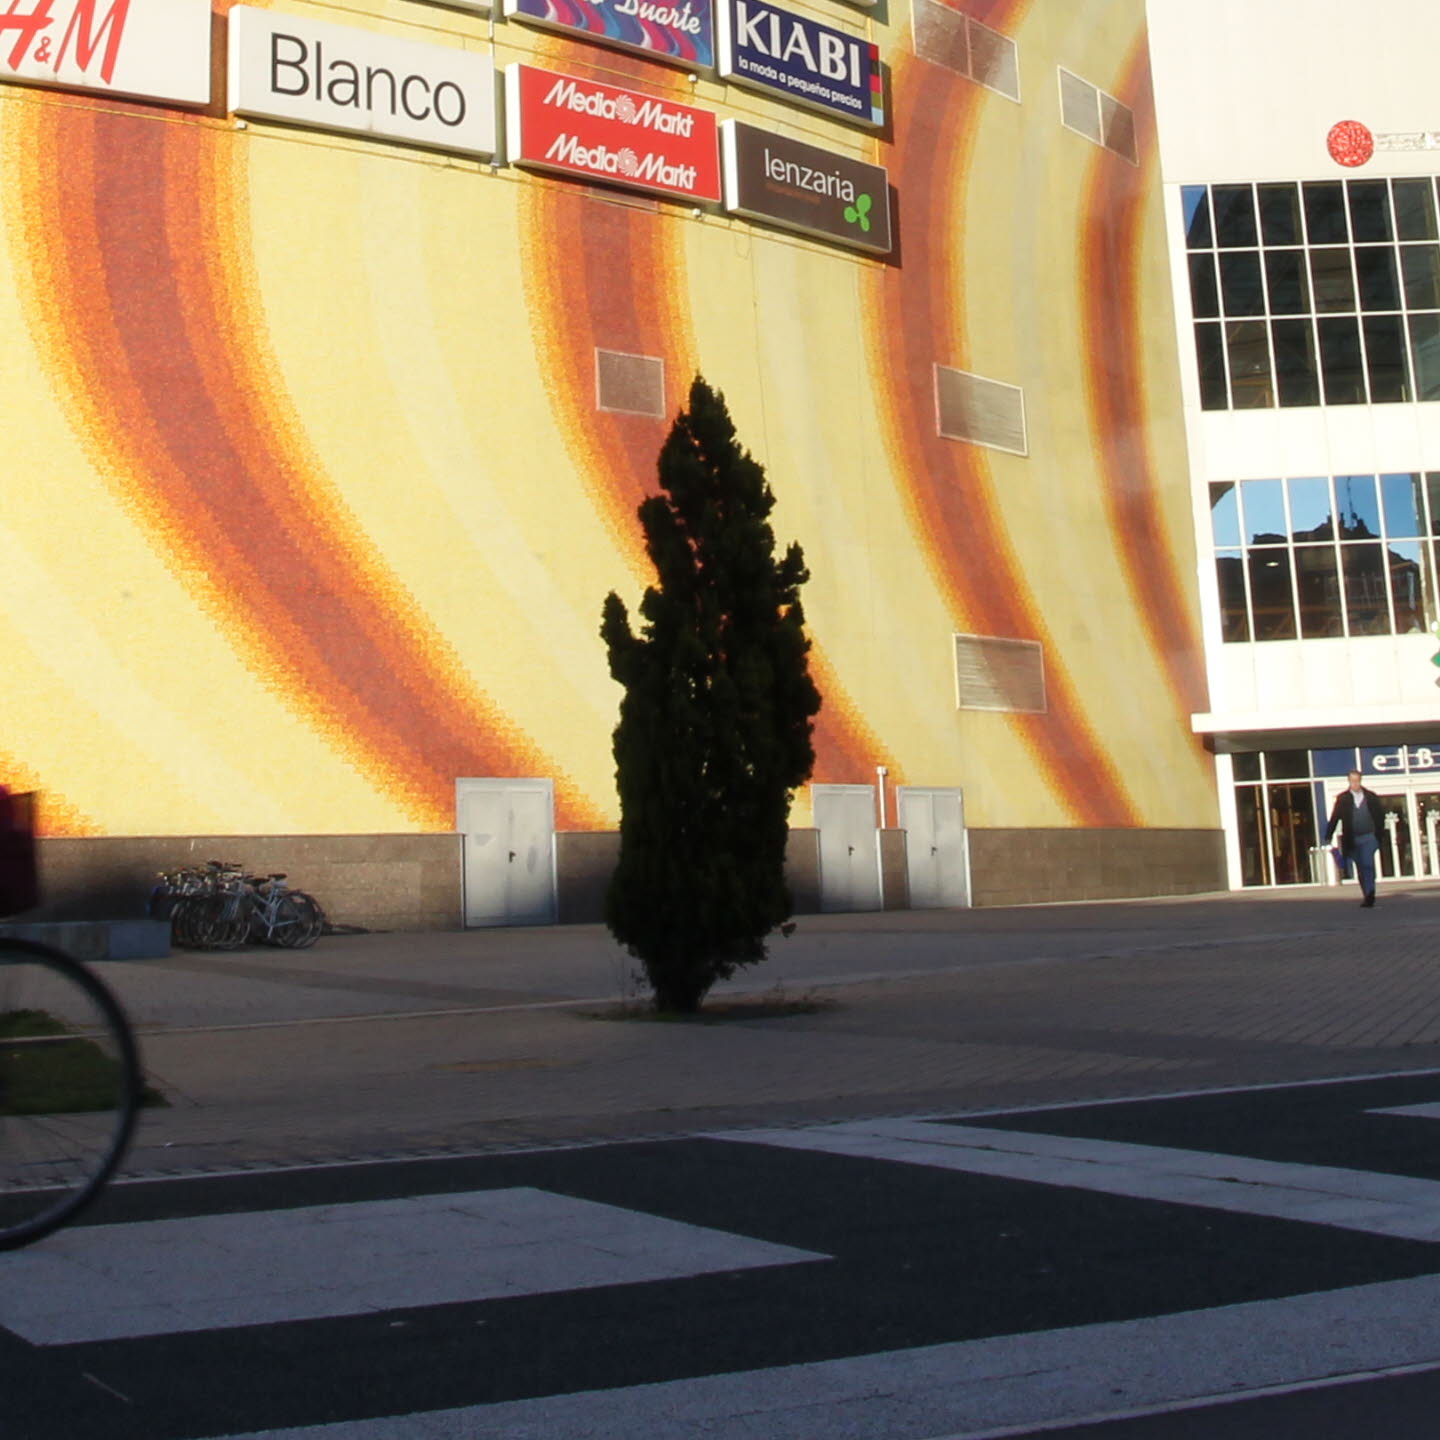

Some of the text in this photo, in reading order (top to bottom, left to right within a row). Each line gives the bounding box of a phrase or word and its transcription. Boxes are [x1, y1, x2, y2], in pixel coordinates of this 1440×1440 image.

[736, 0, 861, 88] KIABI
[271, 32, 466, 126] Blanco
[543, 79, 695, 138] Media Markt
[545, 133, 698, 190] Media Markt
[764, 147, 855, 203] lenzaria
